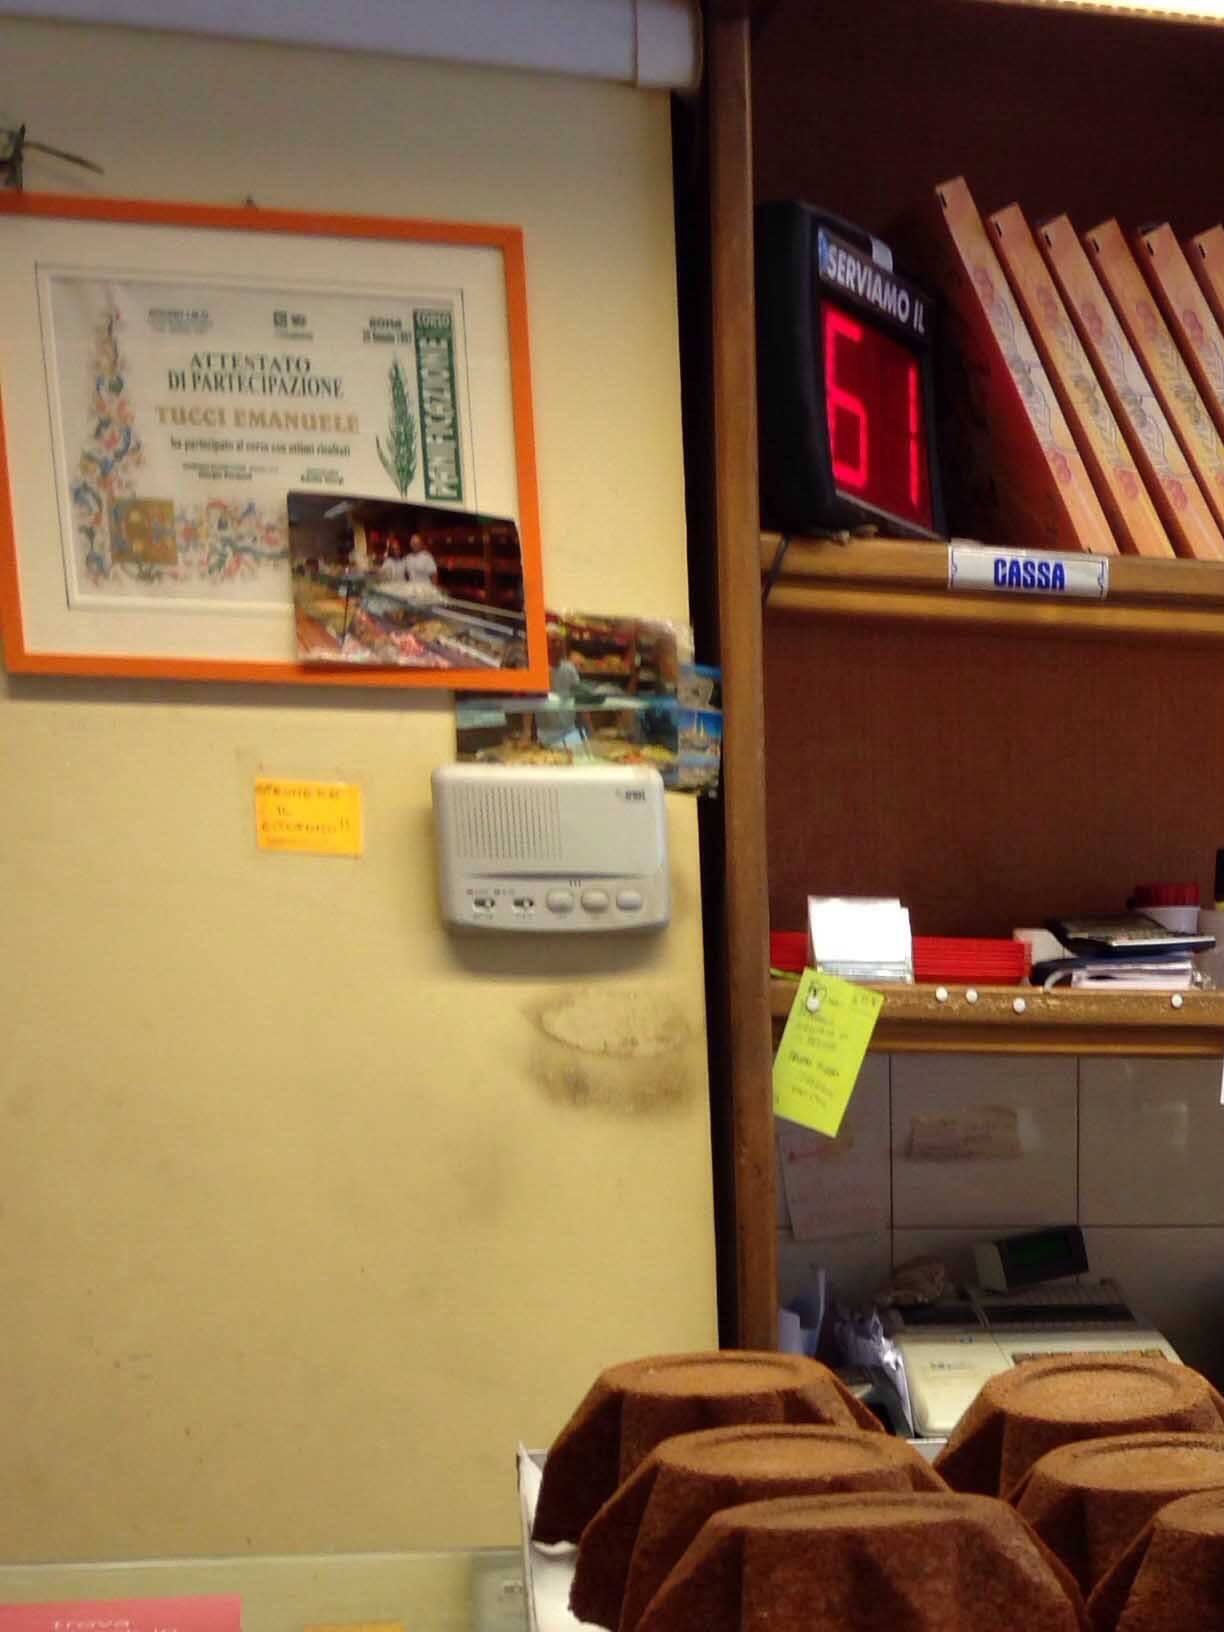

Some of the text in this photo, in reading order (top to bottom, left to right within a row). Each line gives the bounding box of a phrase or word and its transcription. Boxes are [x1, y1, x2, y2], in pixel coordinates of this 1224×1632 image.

[826, 243, 926, 335] SERVIAMO IL
[191, 353, 311, 374] ATTESTATO
[168, 368, 344, 398] DI PARTECIPAZIONE
[154, 406, 360, 434] TUCCI EMANUELE
[823, 303, 920, 507] 61
[993, 557, 1066, 592] CASSA
